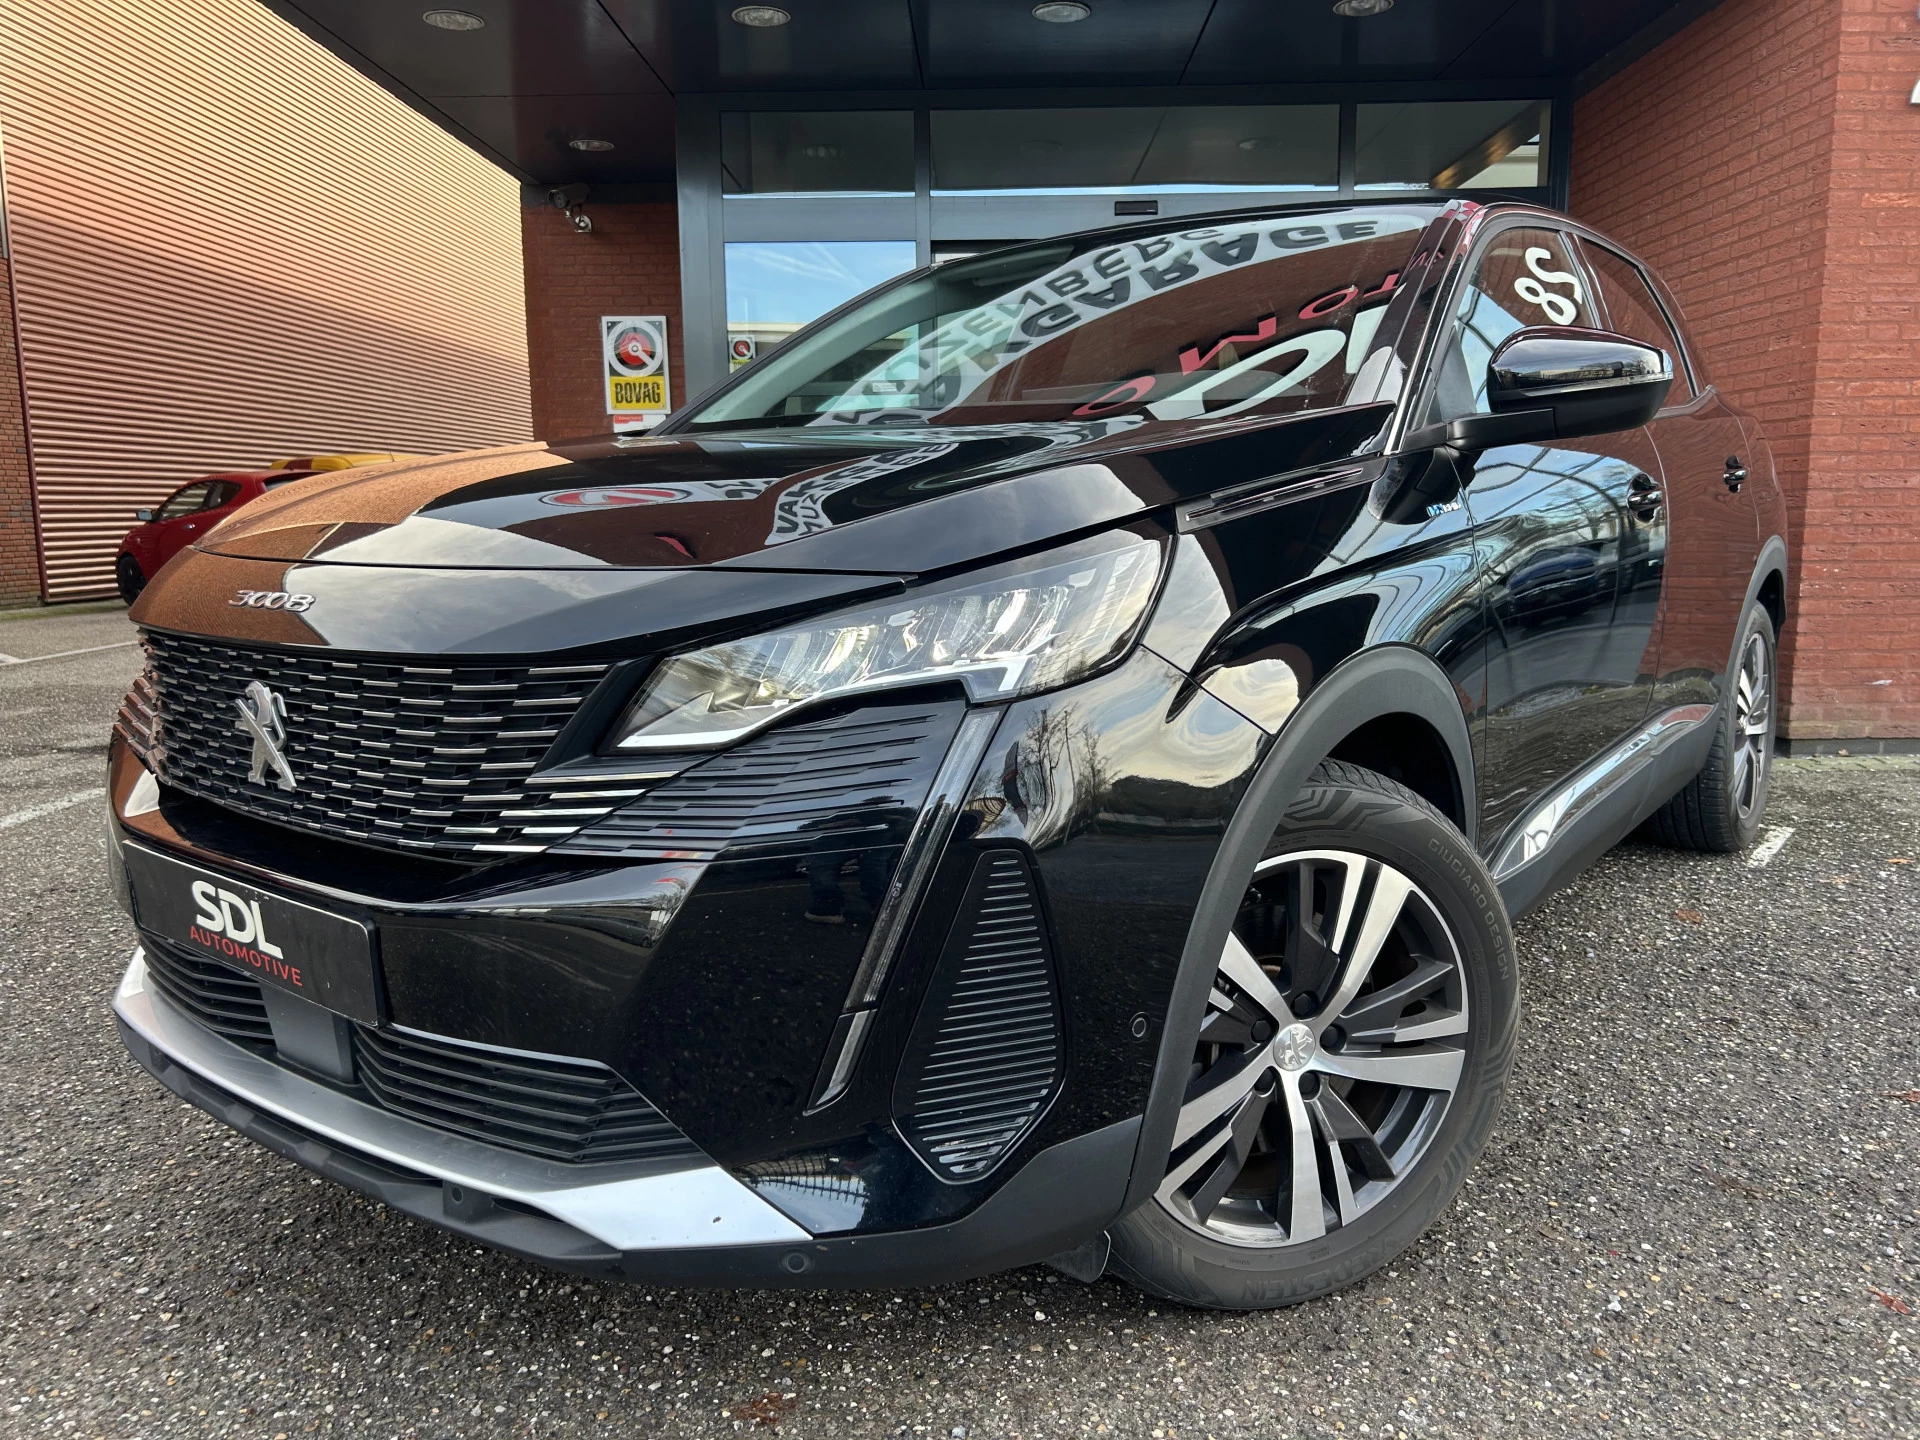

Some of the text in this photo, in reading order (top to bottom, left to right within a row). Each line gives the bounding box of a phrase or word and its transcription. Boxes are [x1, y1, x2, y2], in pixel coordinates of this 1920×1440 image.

[614, 382, 660, 404] BOVAG
[228, 589, 315, 612] 3008
[191, 880, 284, 959] SDL
[1427, 838, 1488, 909] GIUGIARO
[1484, 911, 1510, 980] DESIGN
[190, 925, 303, 987] AUTOMOTIVE
